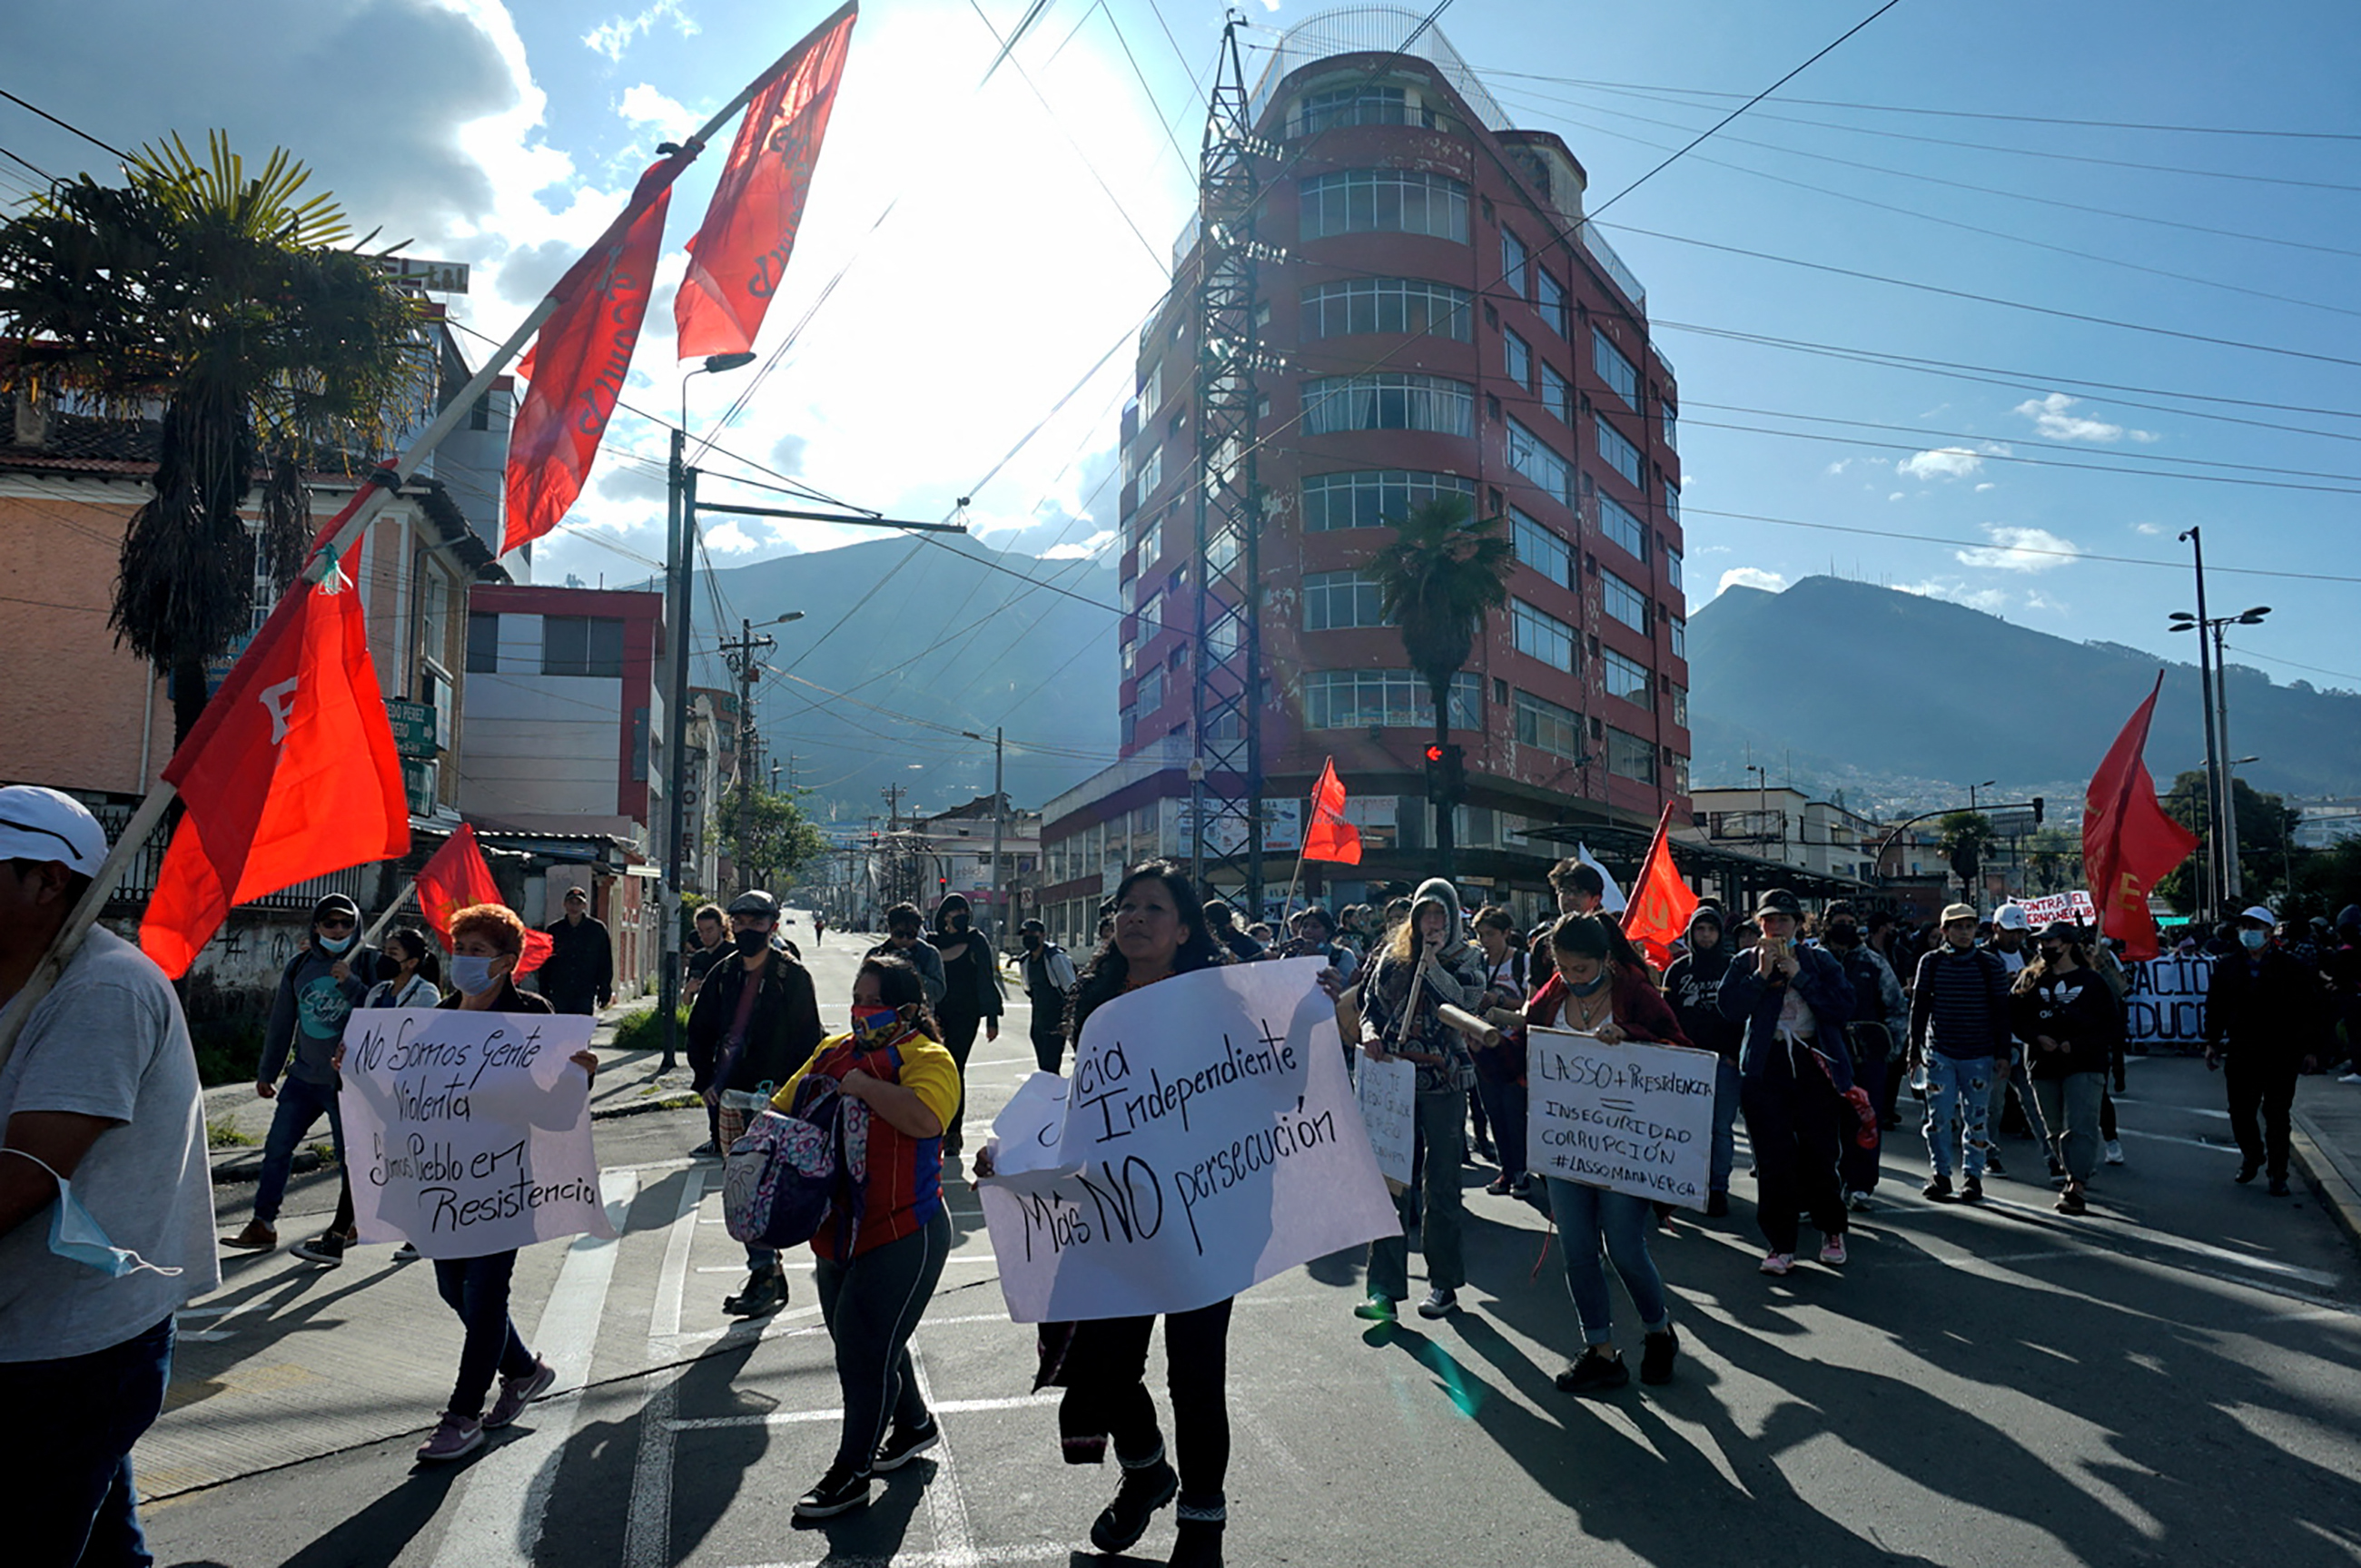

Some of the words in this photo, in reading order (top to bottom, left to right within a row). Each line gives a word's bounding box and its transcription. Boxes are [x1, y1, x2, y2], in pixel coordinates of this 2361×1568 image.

[402, 705, 426, 723] PEREZ
[388, 1018, 470, 1071] Somos
[469, 1025, 541, 1090] Gente
[393, 1073, 470, 1122] Violenta
[1081, 1019, 1297, 1143] Independiente
[1546, 1100, 1692, 1144] INSEGURIDAD
[470, 1140, 526, 1178] en
[1542, 1129, 1676, 1165] CORRUPCIÓN
[1076, 1155, 1163, 1243] NO
[1174, 1095, 1337, 1257] persecución
